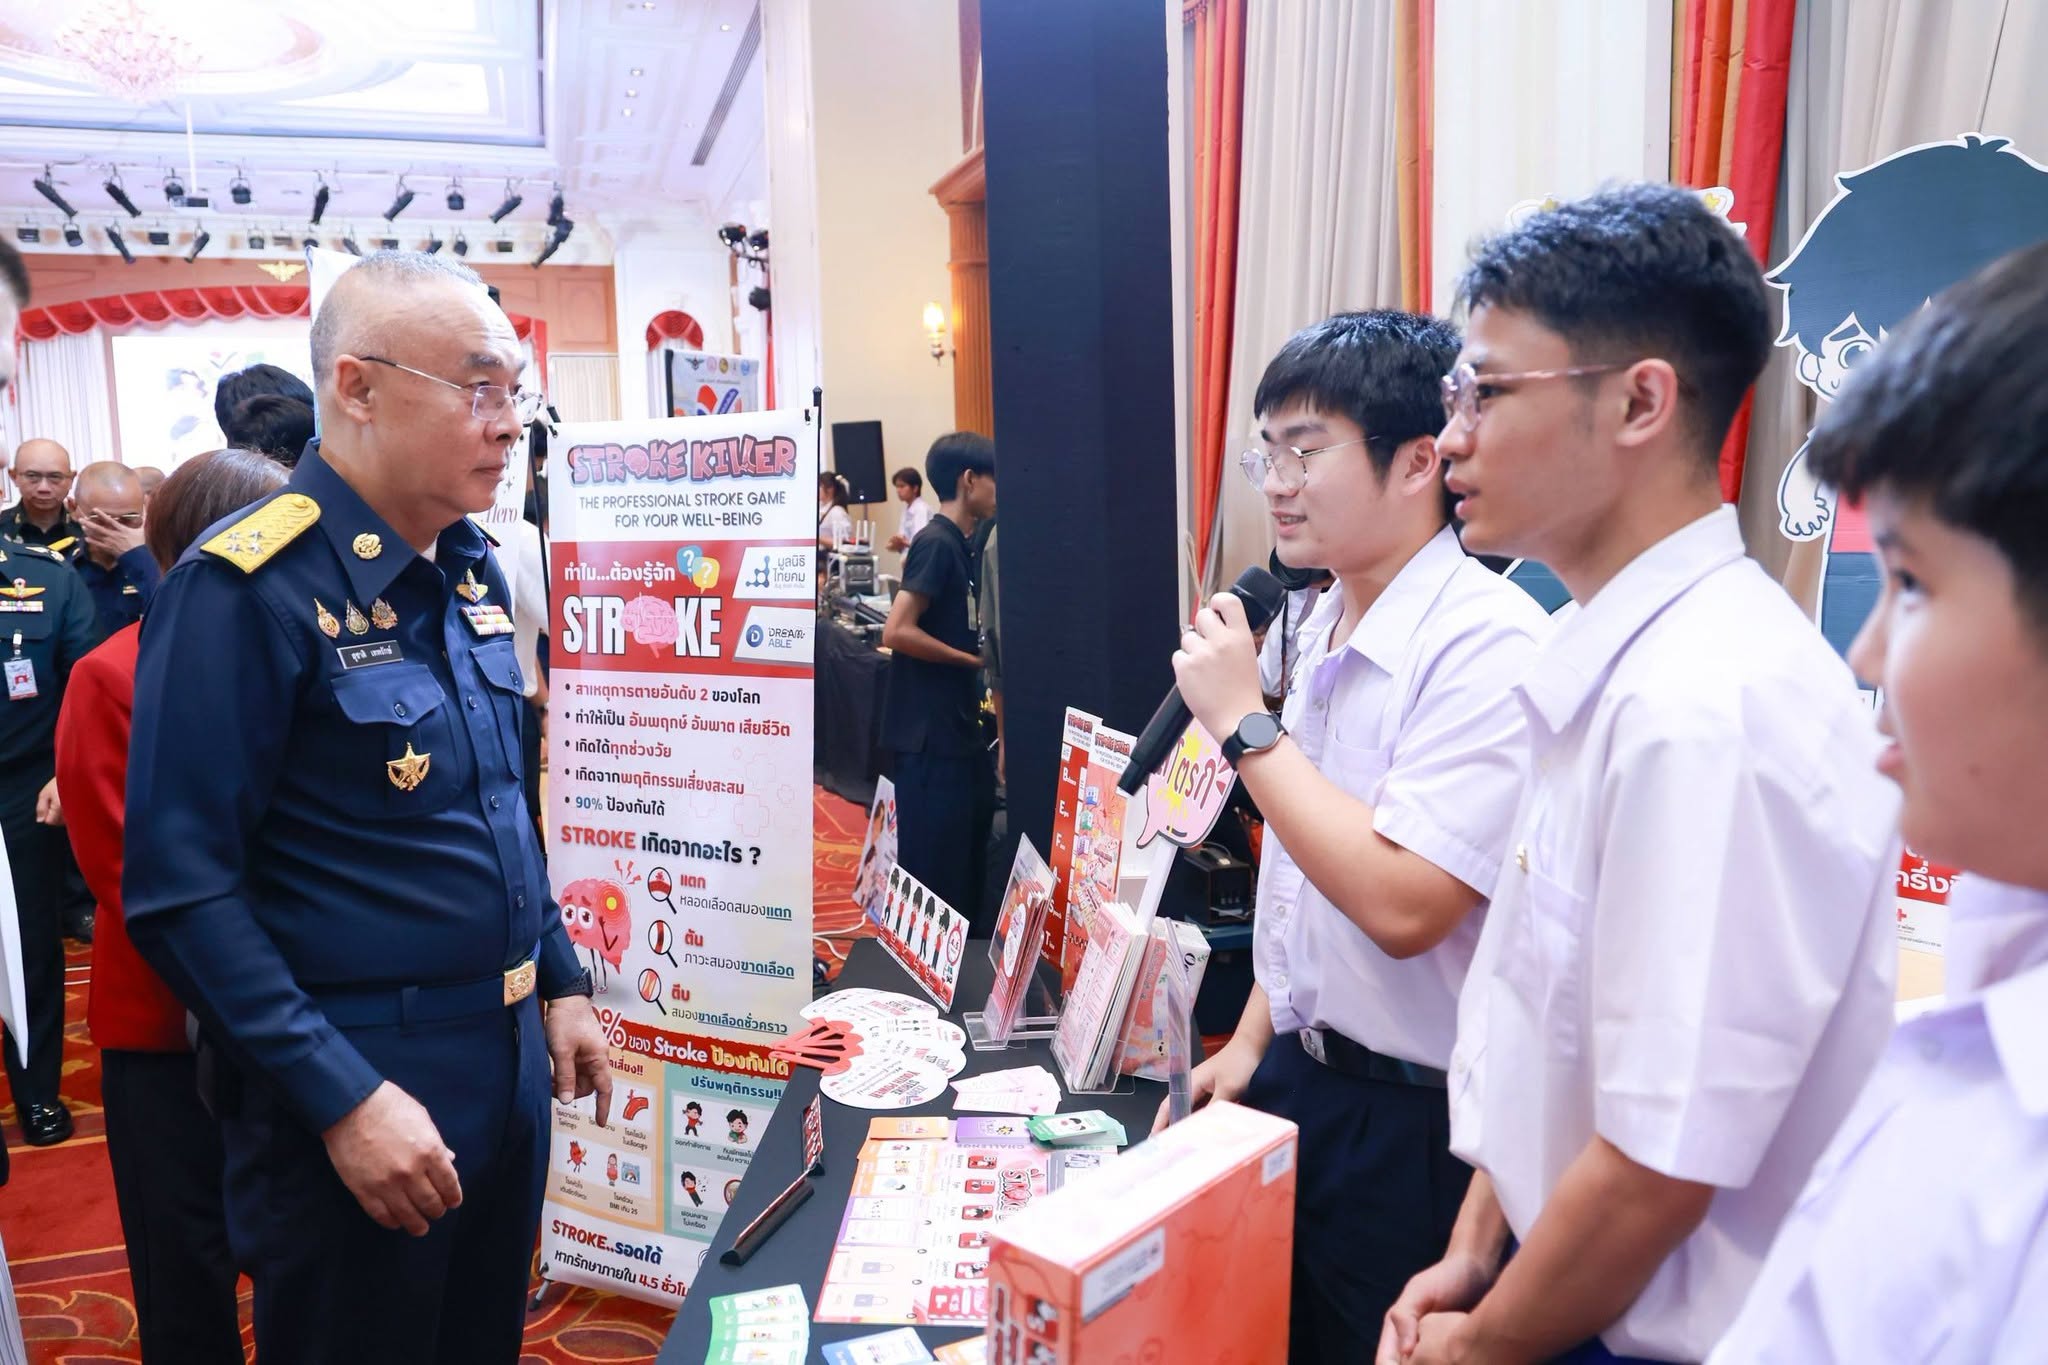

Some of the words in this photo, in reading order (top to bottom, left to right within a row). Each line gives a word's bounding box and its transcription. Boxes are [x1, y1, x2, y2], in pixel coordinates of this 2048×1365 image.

[568, 439, 687, 485] STROKE
[690, 435, 797, 482] KILLER
[579, 496, 600, 509] THE
[602, 494, 691, 509] PROFESSIONAL
[694, 492, 743, 506] STROKE
[747, 491, 786, 505] GAME
[615, 514, 639, 528] FOR
[643, 513, 678, 527] YOUR
[682, 512, 763, 527] WELL-BEING
[777, 555, 806, 570] มูลนิธิ
[773, 567, 806, 582] ไทยคม
[768, 638, 792, 649] ABLE
[576, 682, 697, 702] สาเหตุการตายอันดับ
[699, 688, 709, 702] 2
[712, 687, 761, 705] ของโลก
[575, 709, 625, 727] ทำให้เป็น
[629, 711, 688, 733] อัมพฤกษ์
[691, 715, 735, 734] อัมพาต
[739, 718, 791, 737] เสียชีวิต
[575, 738, 672, 760] เกิดได้ทุกช่วงวัย
[575, 765, 745, 795] เกิดจากพฤติกรรมเสี่ยงสะสม
[1157, 737, 1217, 810] โตรก
[575, 795, 603, 811] 90%
[606, 796, 665, 817] ป้องกันได้
[561, 825, 636, 850] STROKE
[641, 831, 743, 864] เกิดจากอะไร
[750, 846, 762, 866] ?
[680, 874, 707, 889] แตก
[679, 894, 793, 918] หลอดเลือดสมองแตก
[684, 928, 704, 947] ตัน
[684, 951, 795, 977] ภาวะสมองขาดเลือด
[672, 984, 690, 1002] ตีบ
[671, 1007, 788, 1033] สมองขาดเลือดชั่วคราว
[628, 1035, 651, 1052] ของ
[653, 1036, 708, 1063] Stroke
[691, 1075, 783, 1100] ปรับพฤติกรรม!!
[630, 1207, 639, 1216] 25
[554, 1249, 636, 1284] หากรักษาภายใน
[638, 1273, 659, 1289] 4.5
